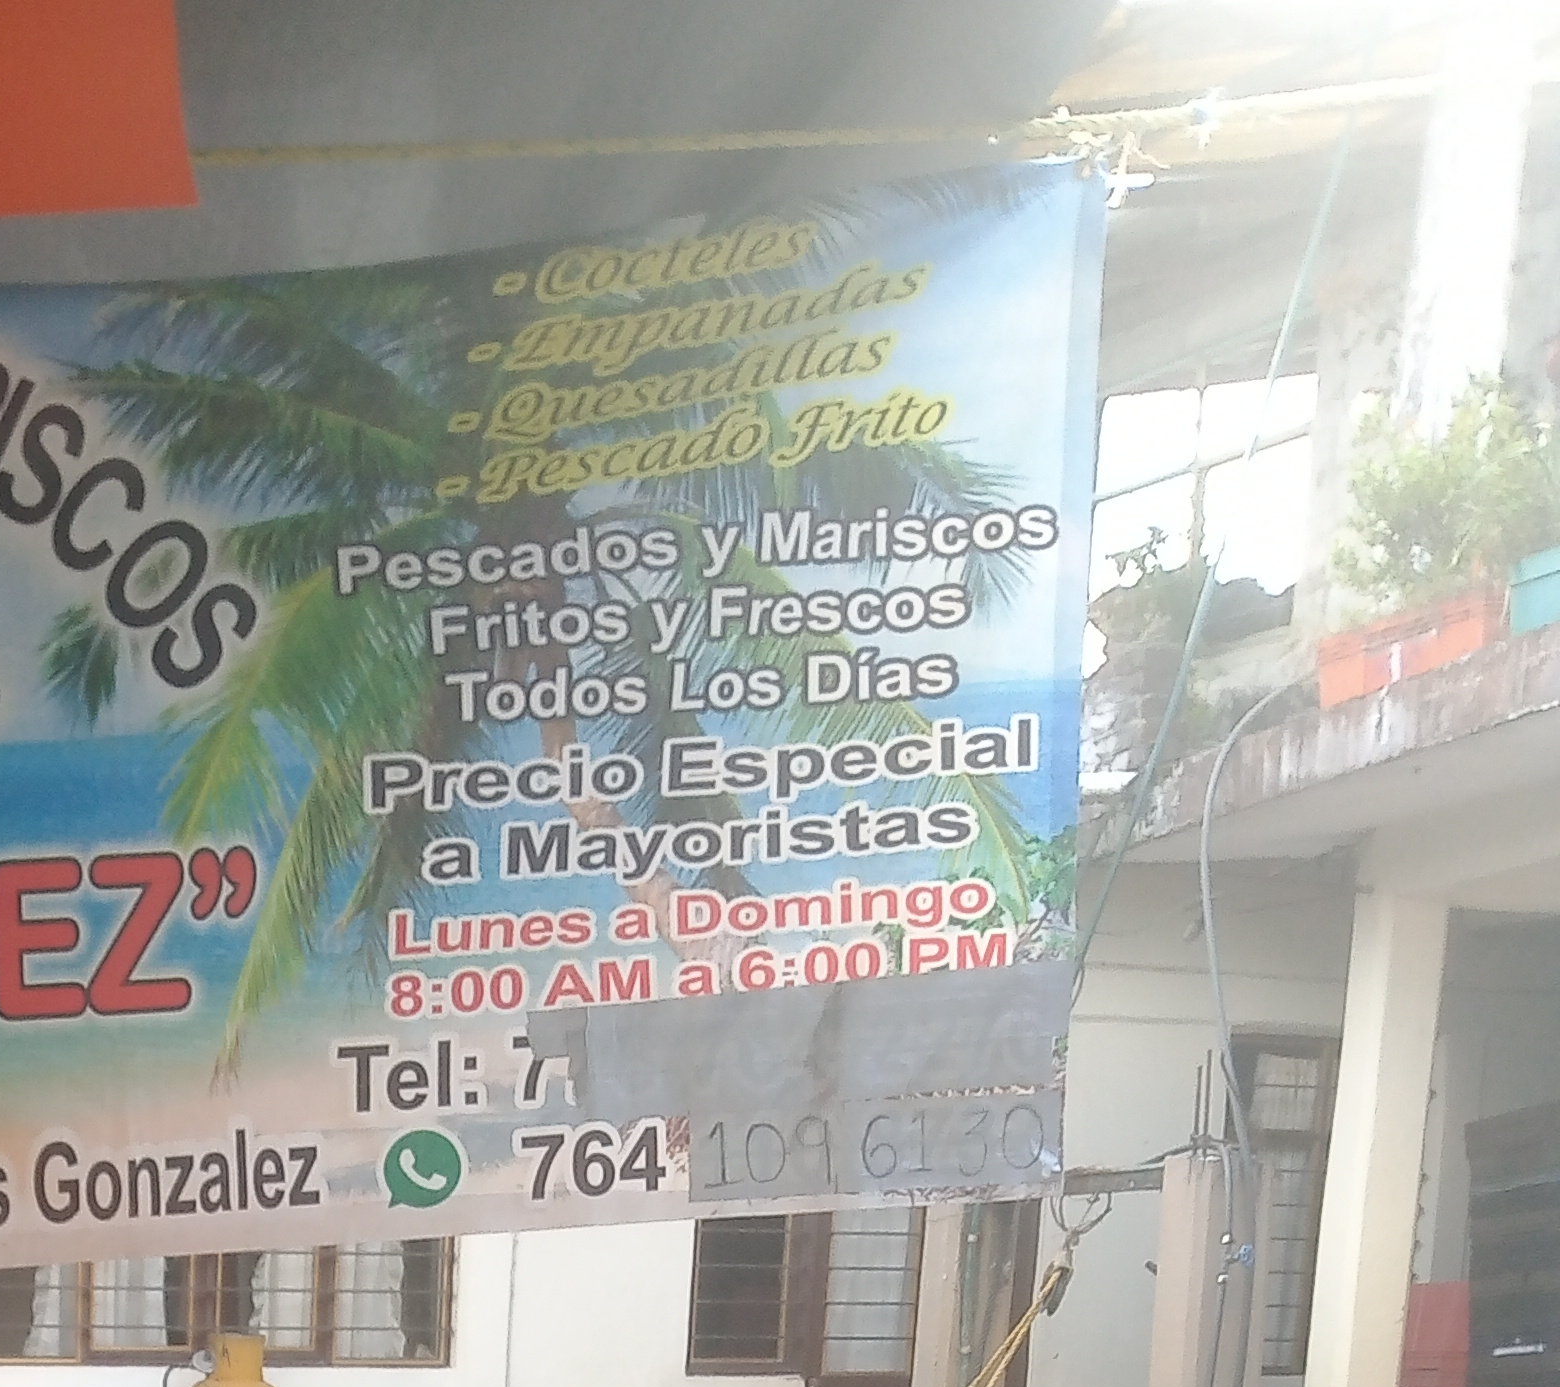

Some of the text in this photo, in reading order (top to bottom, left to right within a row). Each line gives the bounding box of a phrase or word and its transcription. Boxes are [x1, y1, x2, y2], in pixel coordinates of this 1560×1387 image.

[775, 392, 950, 464] Frito
[336, 505, 1060, 595] Pescados y Mariscos
[428, 583, 969, 655] Fritos y Frescos
[444, 648, 958, 722] Todos Los Días
[368, 717, 1035, 811] Precio Especial
[426, 799, 975, 881] a Mayoristas
[394, 878, 991, 958] Lunes a Domingo
[389, 931, 1009, 1019] 8:00 AM a 6:00 PM
[336, 1039, 480, 1113] Tel:
[33, 1128, 322, 1224] Gonzalez
[521, 1125, 668, 1201] 764
